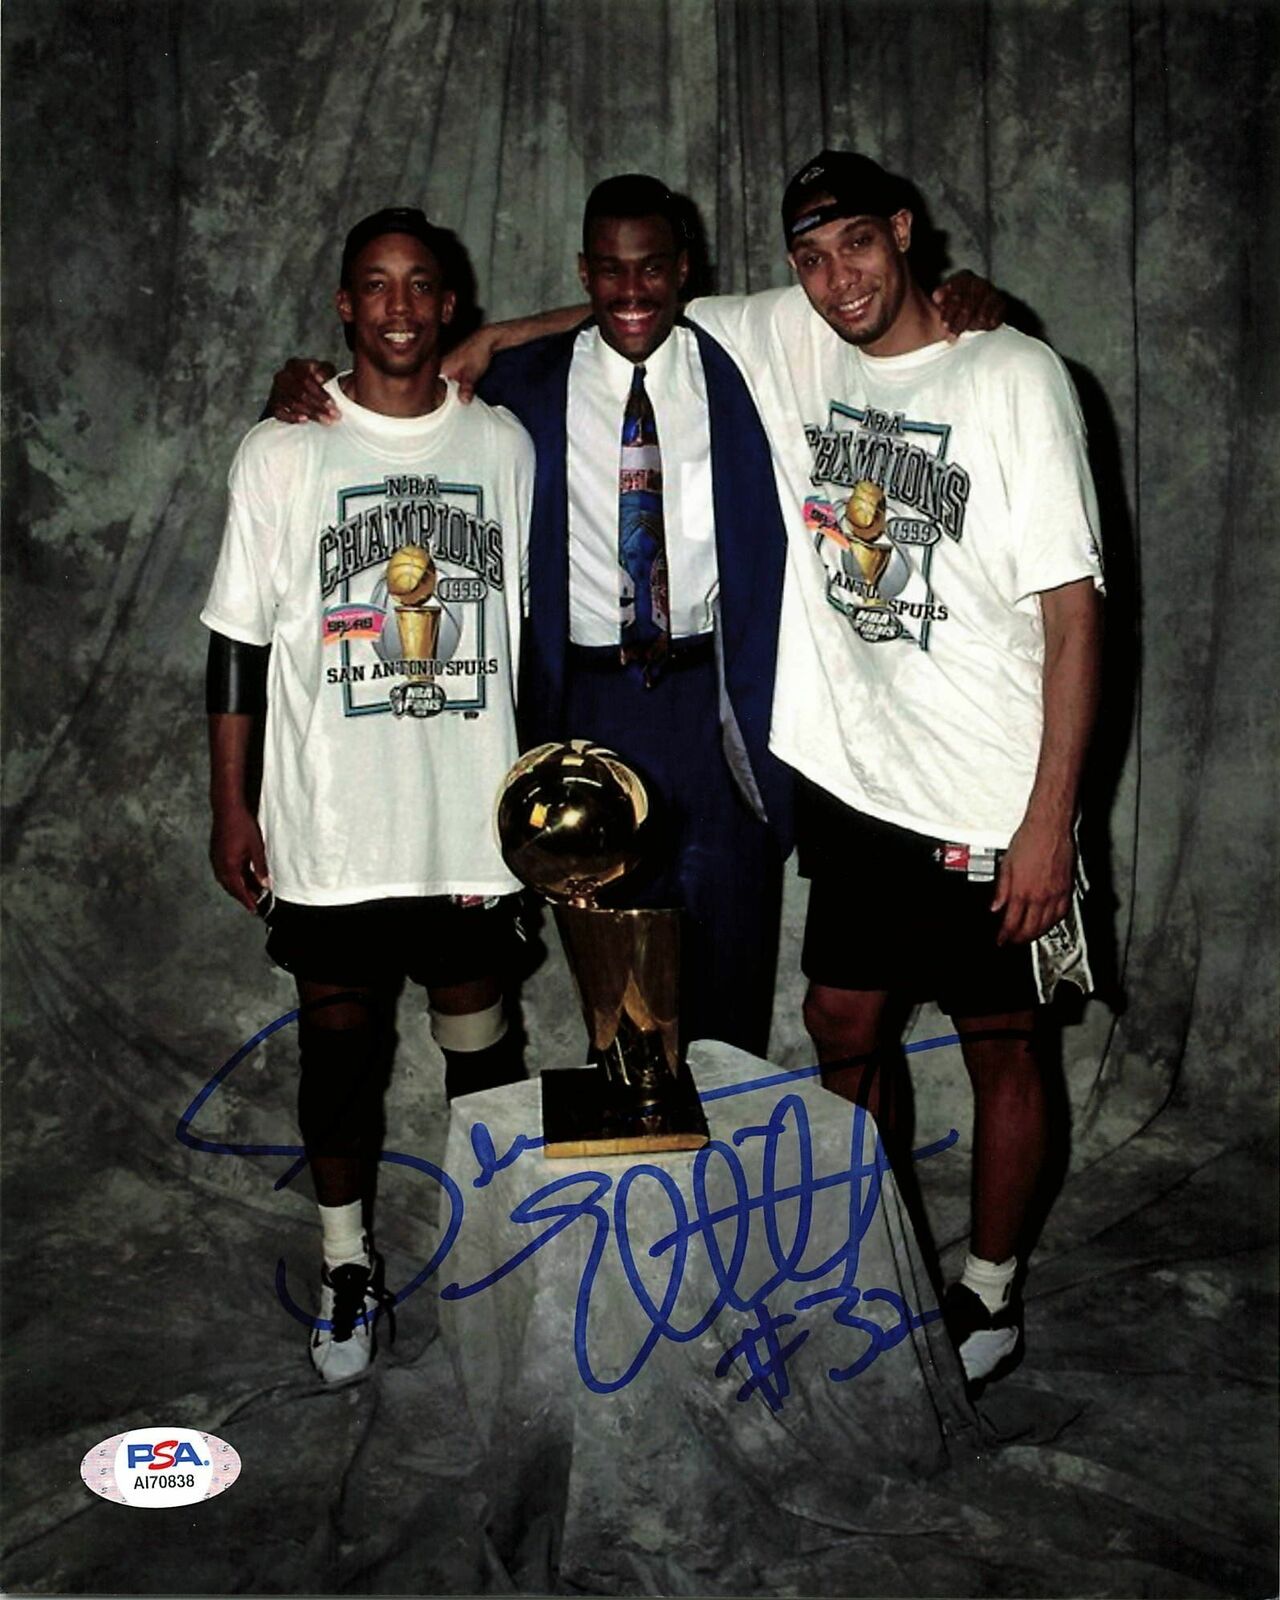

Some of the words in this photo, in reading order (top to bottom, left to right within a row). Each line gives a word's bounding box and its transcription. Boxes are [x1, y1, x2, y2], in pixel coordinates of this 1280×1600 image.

[861, 407, 904, 432] NBA
[386, 475, 439, 498] NBA
[892, 522, 932, 542] 1999
[319, 500, 503, 600] CHAMPIONS
[446, 581, 481, 599] 1999
[888, 600, 949, 621] SPURS
[327, 666, 365, 684] SAN
[371, 660, 443, 680] ANTONIO
[446, 659, 498, 677] SPURS
[133, 1474, 195, 1490] AI70838
